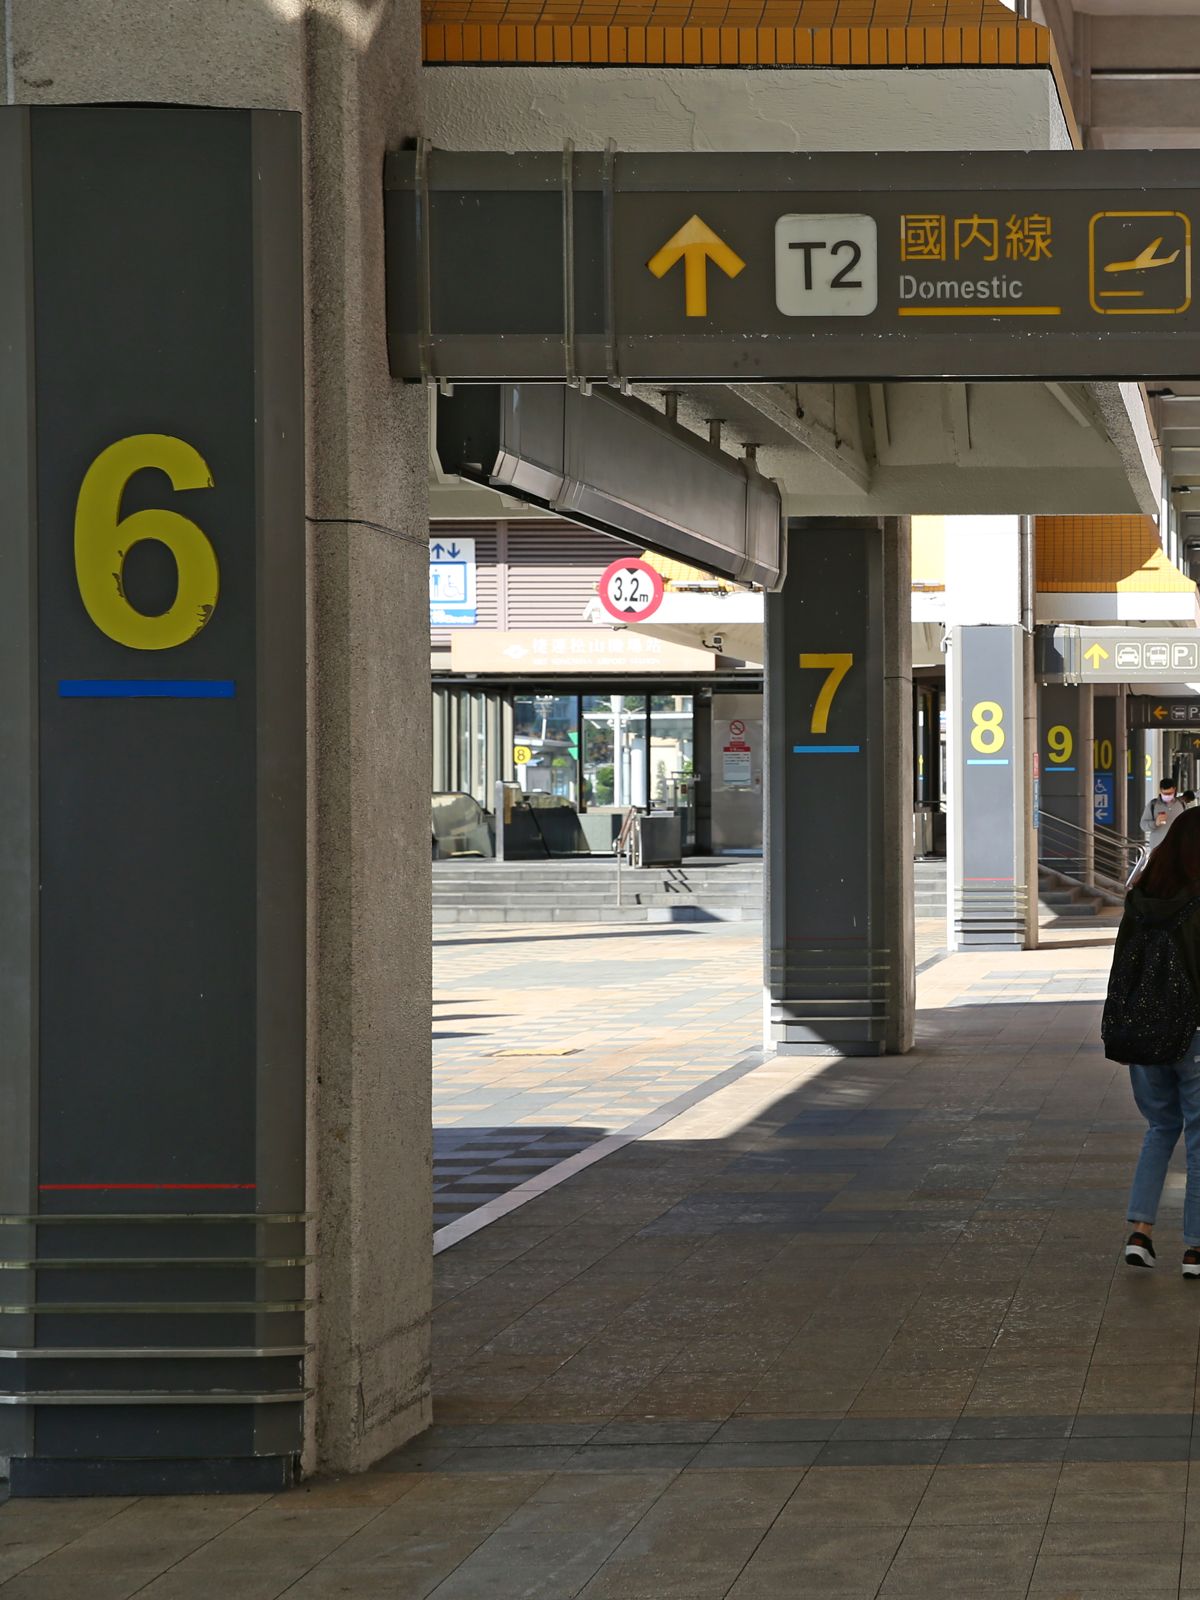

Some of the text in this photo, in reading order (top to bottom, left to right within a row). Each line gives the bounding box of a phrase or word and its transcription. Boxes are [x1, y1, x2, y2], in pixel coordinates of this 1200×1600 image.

[900, 213, 1053, 262] 國內線
[788, 240, 863, 291] T2
[900, 274, 1024, 300] Domestic
[74, 433, 219, 650] 6
[800, 653, 853, 733] 7
[970, 701, 1005, 754] 8
[1047, 725, 1073, 763] 9
[1094, 739, 1112, 769] 10
